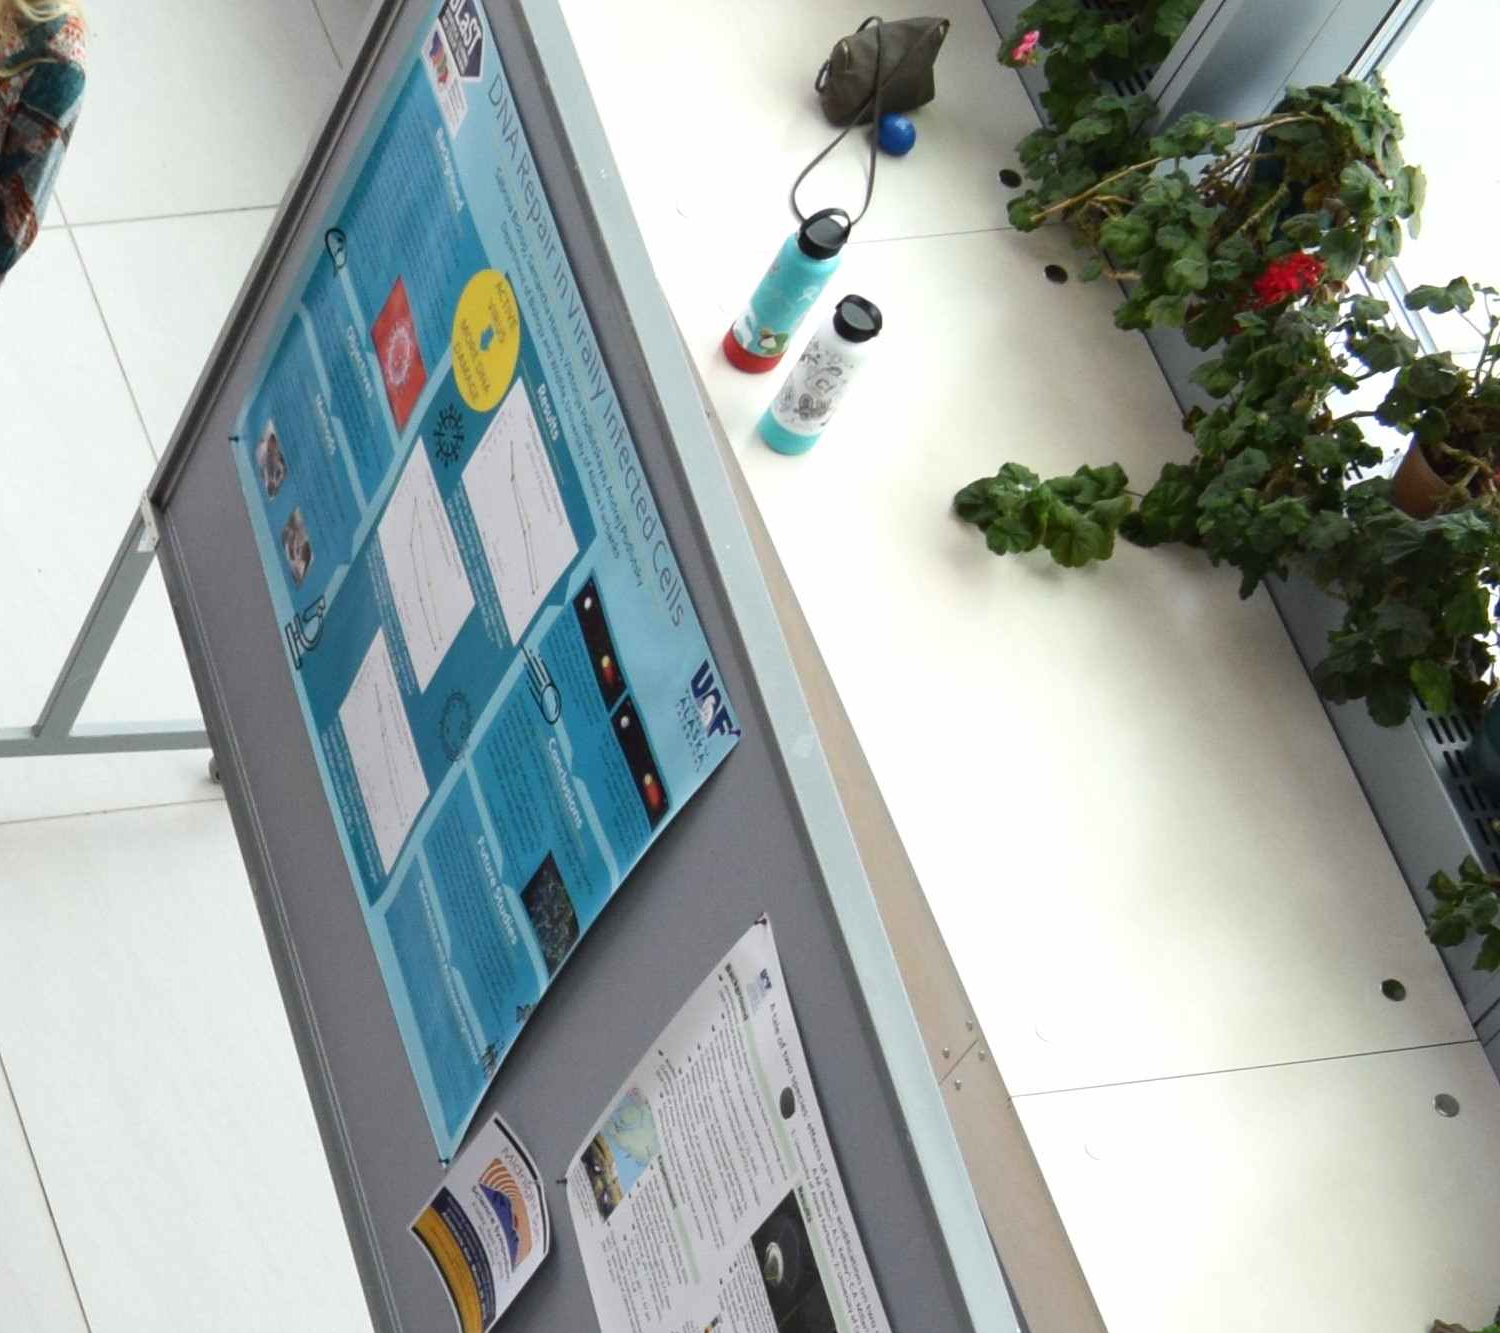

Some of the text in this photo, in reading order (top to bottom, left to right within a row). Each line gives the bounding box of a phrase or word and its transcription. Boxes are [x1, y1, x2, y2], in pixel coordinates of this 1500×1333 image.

[435, 127, 463, 211] Background
[495, 281, 518, 328] ACTIVE
[346, 325, 373, 398] Objectives
[453, 342, 478, 400] DAMAGE
[460, 319, 490, 392] MORE DNA
[488, 74, 683, 626] DNA Repair in Virally Infected Cells
[315, 394, 335, 454] Methods
[537, 383, 558, 440] Results
[679, 697, 704, 760] ALASKA
[688, 656, 732, 752] UAF
[548, 737, 582, 828] Conclusions
[477, 835, 516, 944] Future Studies
[725, 964, 739, 992] Background
[657, 1154, 676, 1208] Experiment
[797, 1185, 811, 1222] Results
